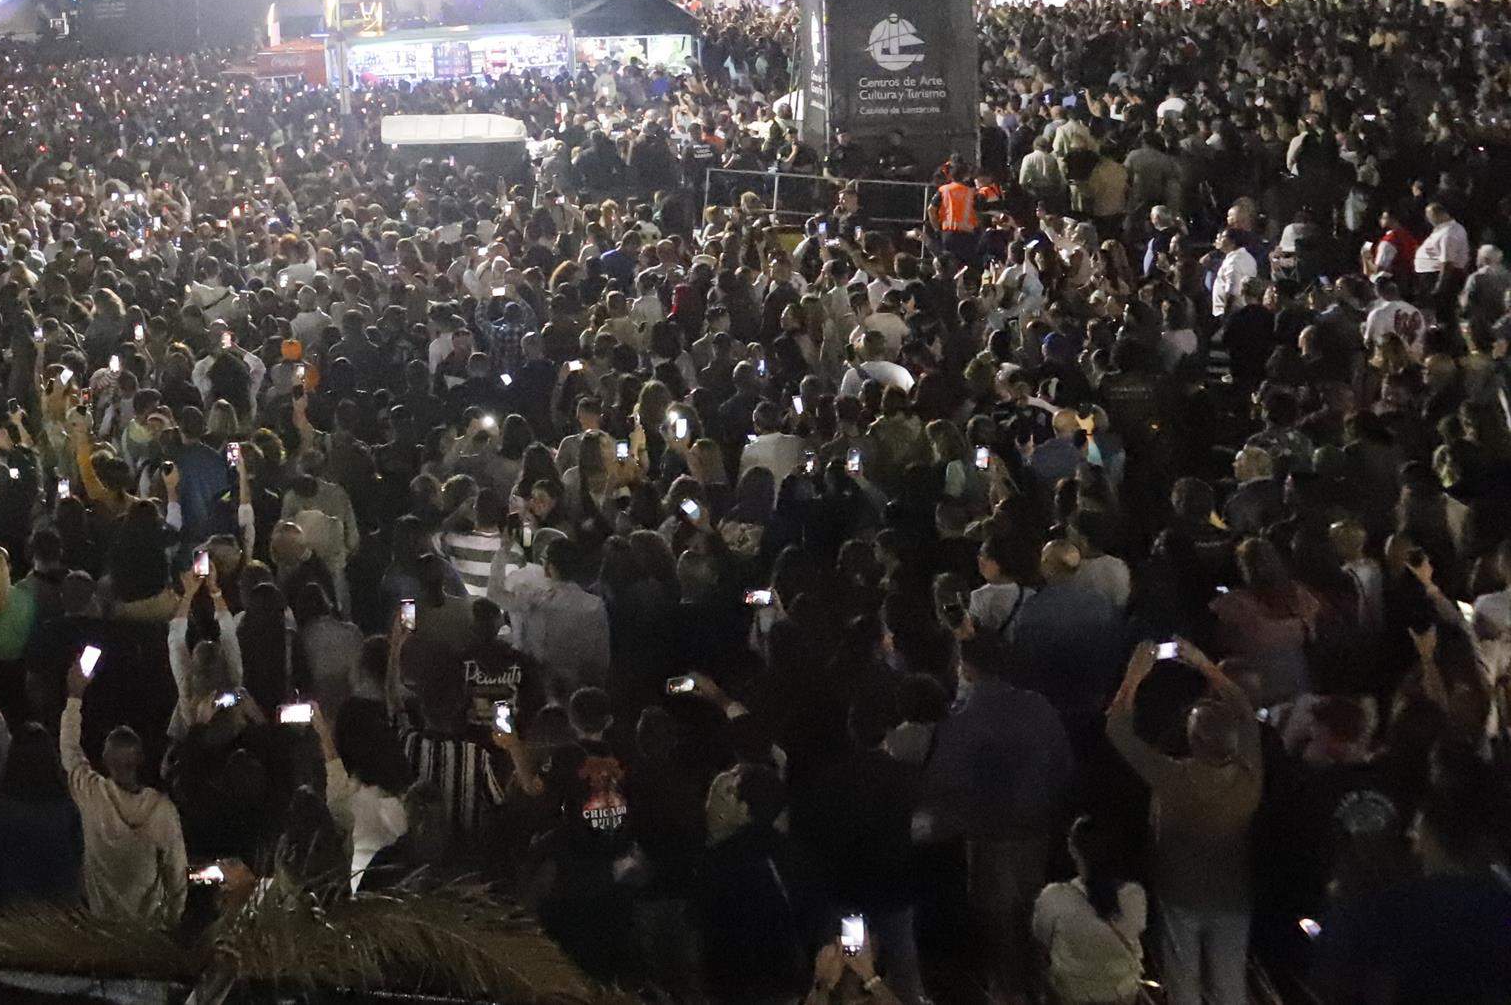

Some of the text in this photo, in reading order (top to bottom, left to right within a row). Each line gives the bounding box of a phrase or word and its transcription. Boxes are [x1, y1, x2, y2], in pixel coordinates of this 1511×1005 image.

[858, 75, 946, 88] Centros de Arte,
[858, 89, 947, 102] Cultura y Turismo
[582, 805, 627, 819] CHICAGO
